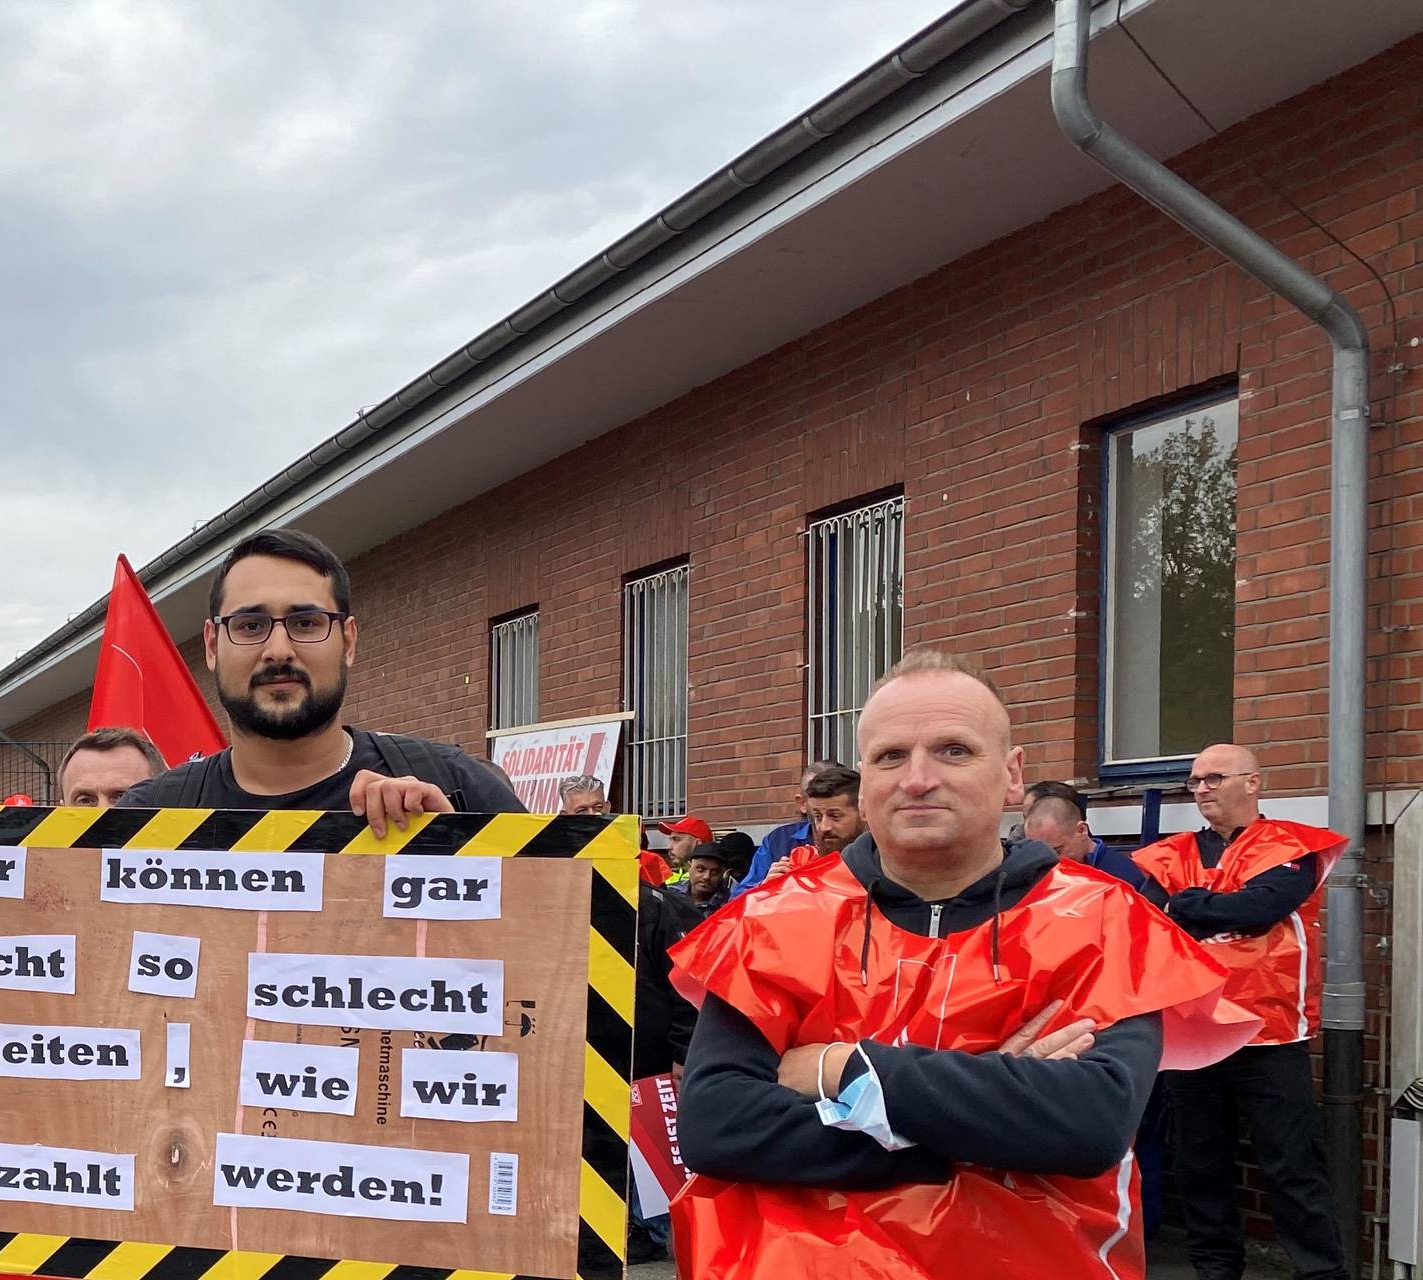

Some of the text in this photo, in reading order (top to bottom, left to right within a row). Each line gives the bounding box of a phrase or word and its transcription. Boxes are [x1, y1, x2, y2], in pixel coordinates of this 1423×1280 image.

[106, 857, 306, 892] können
[391, 876, 489, 909] gar
[137, 954, 194, 981] so
[254, 976, 488, 1014] schlecht
[256, 1066, 351, 1101] wie
[413, 1072, 507, 1107] wir
[655, 1077, 678, 1114] ZEIT
[220, 1164, 443, 1206] werden!
